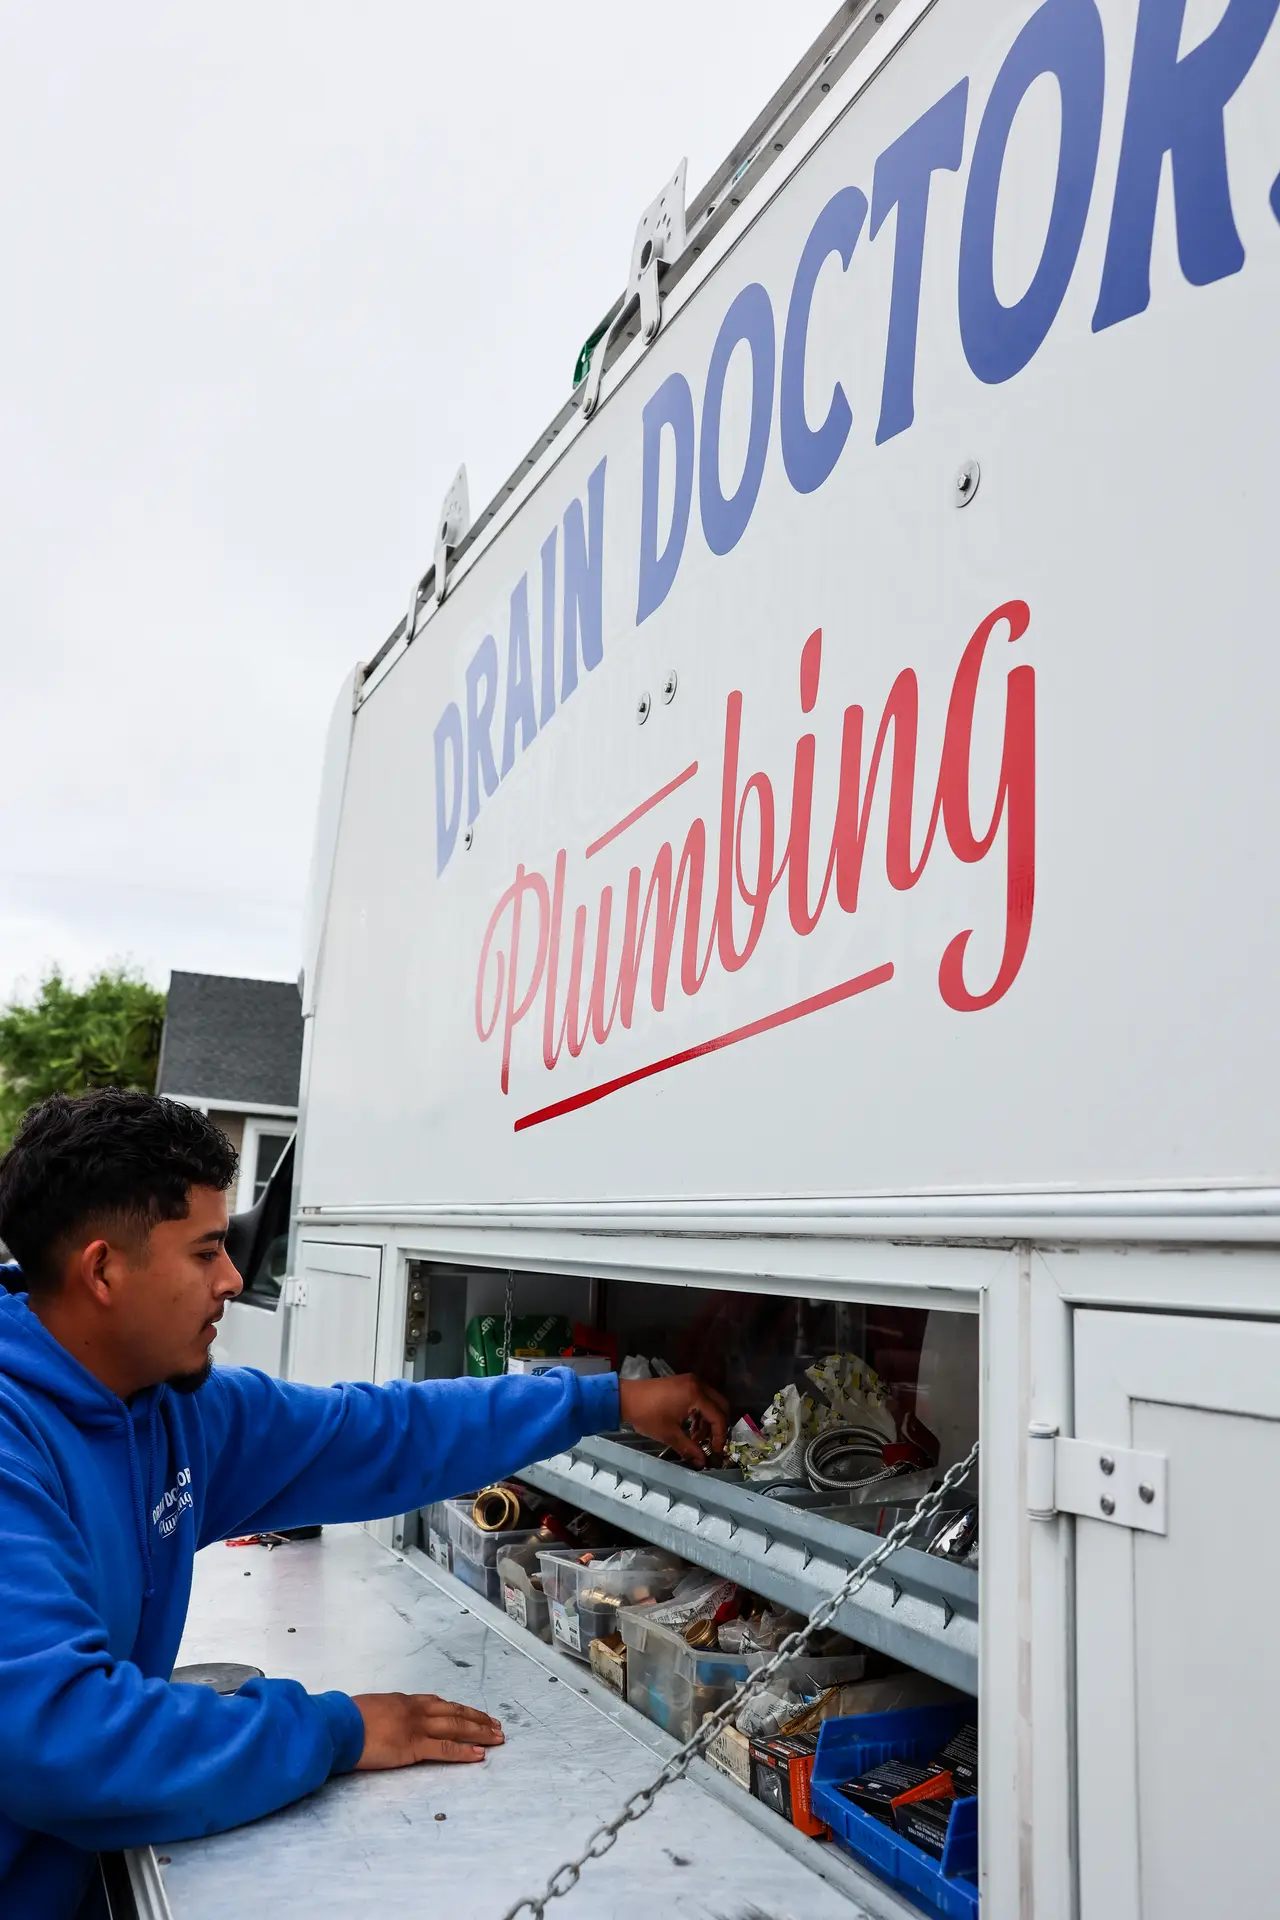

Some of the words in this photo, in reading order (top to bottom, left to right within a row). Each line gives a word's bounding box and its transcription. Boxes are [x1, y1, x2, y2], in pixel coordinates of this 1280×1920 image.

[434, 456, 607, 877] DRAIN
[636, 0, 1280, 626] DOCTOR
[475, 600, 1036, 1095] Plumbing
[159, 1492, 193, 1533] Plumng
